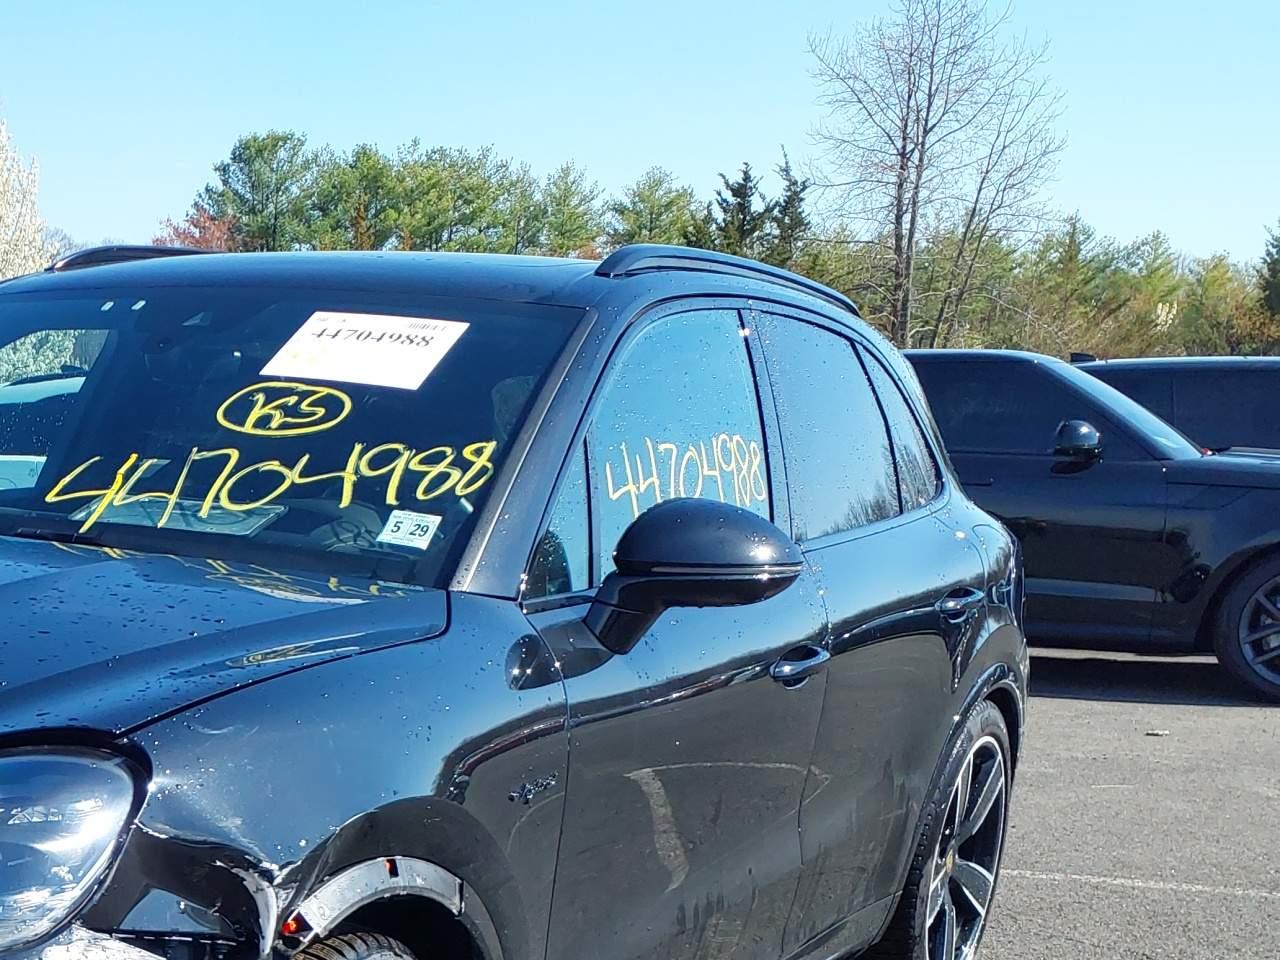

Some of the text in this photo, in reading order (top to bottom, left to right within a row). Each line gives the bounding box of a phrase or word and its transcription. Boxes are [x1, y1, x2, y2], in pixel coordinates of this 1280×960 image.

[312, 327, 434, 347] 44704988
[45, 440, 497, 534] 44704988
[605, 432, 767, 519] 44704988
[391, 521, 430, 537] 5 29
